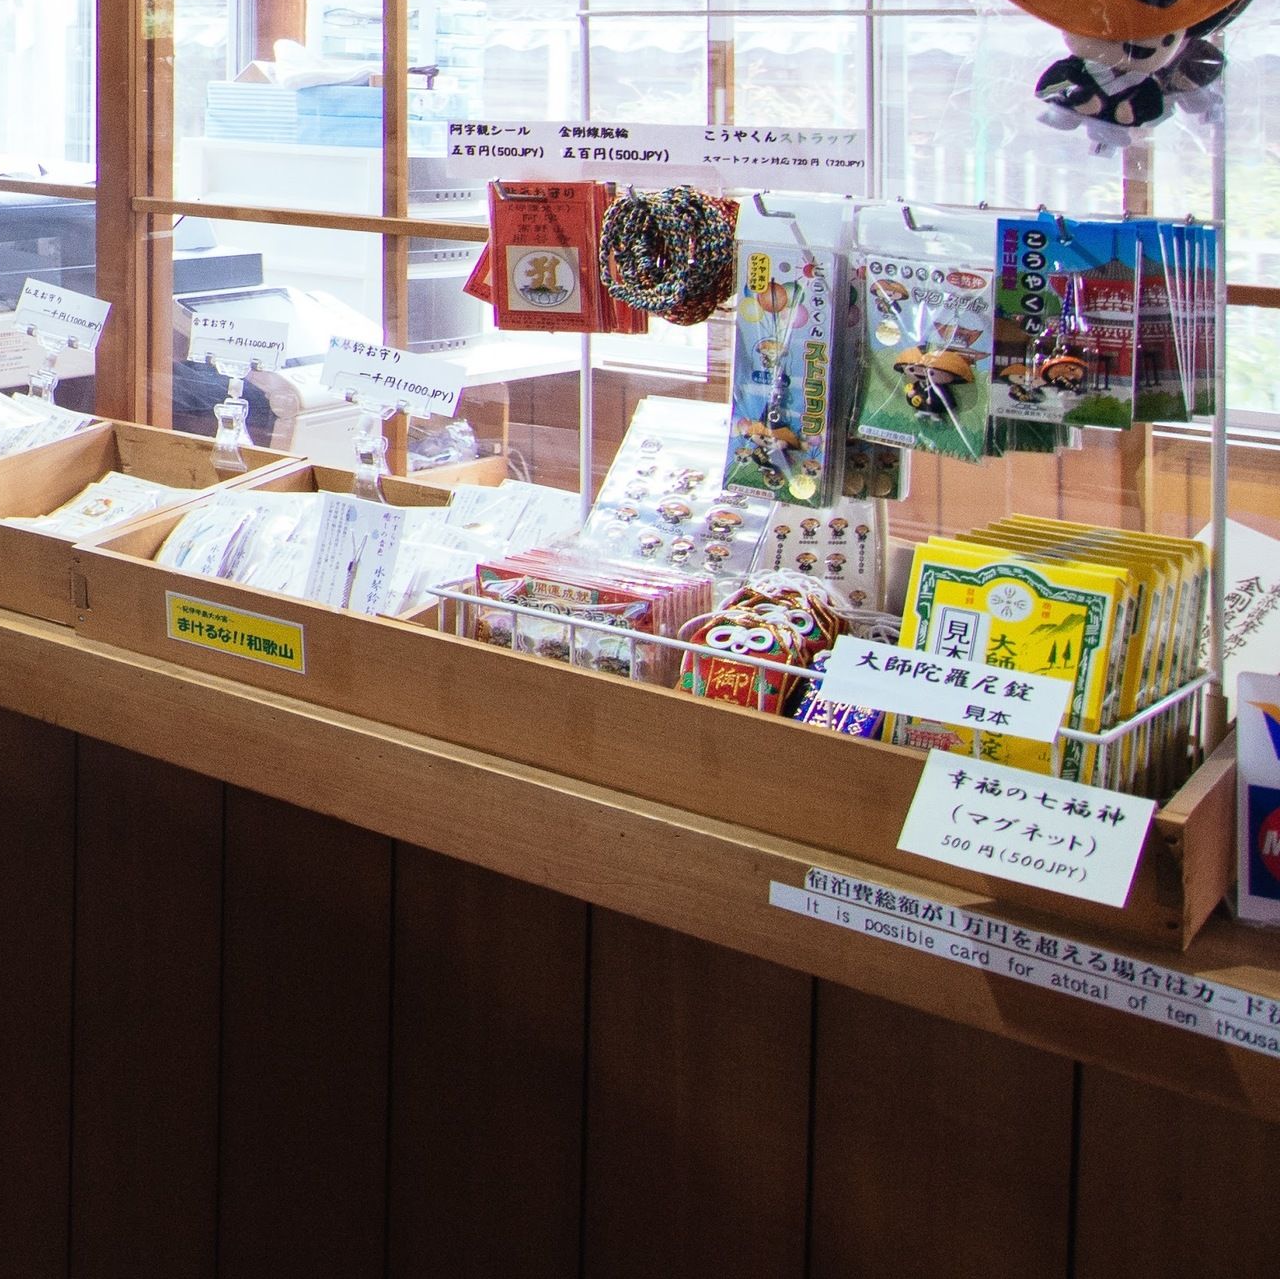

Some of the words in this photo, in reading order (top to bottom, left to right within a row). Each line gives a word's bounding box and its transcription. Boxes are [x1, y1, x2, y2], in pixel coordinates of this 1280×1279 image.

[449, 123, 531, 137] 阿字観シール
[704, 128, 859, 146] こうやくんストラップ
[451, 145, 545, 159] 五百円(500JPY)
[562, 146, 670, 164] 五百円(500JPY)
[1021, 229, 1046, 335] こうやくん
[217, 336, 285, 351] 一千円(1000JPY)
[359, 372, 454, 404] 一千円(1000JPY)
[801, 340, 829, 436] ストラップ
[177, 617, 294, 660] まけるな!!和歌山
[855, 650, 1036, 703] 大師陀羅尼錠
[962, 704, 1012, 726] 見本
[948, 769, 1126, 828] 幸福の七福神
[951, 802, 1099, 858] (マグネット)
[806, 896, 820, 915] It
[836, 907, 851, 924] is
[864, 918, 935, 950] possible
[950, 941, 991, 967] card
[1007, 955, 1035, 978] for
[1050, 973, 1110, 1001] atotal
[1127, 993, 1148, 1012] of
[1167, 1003, 1199, 1027] ten
